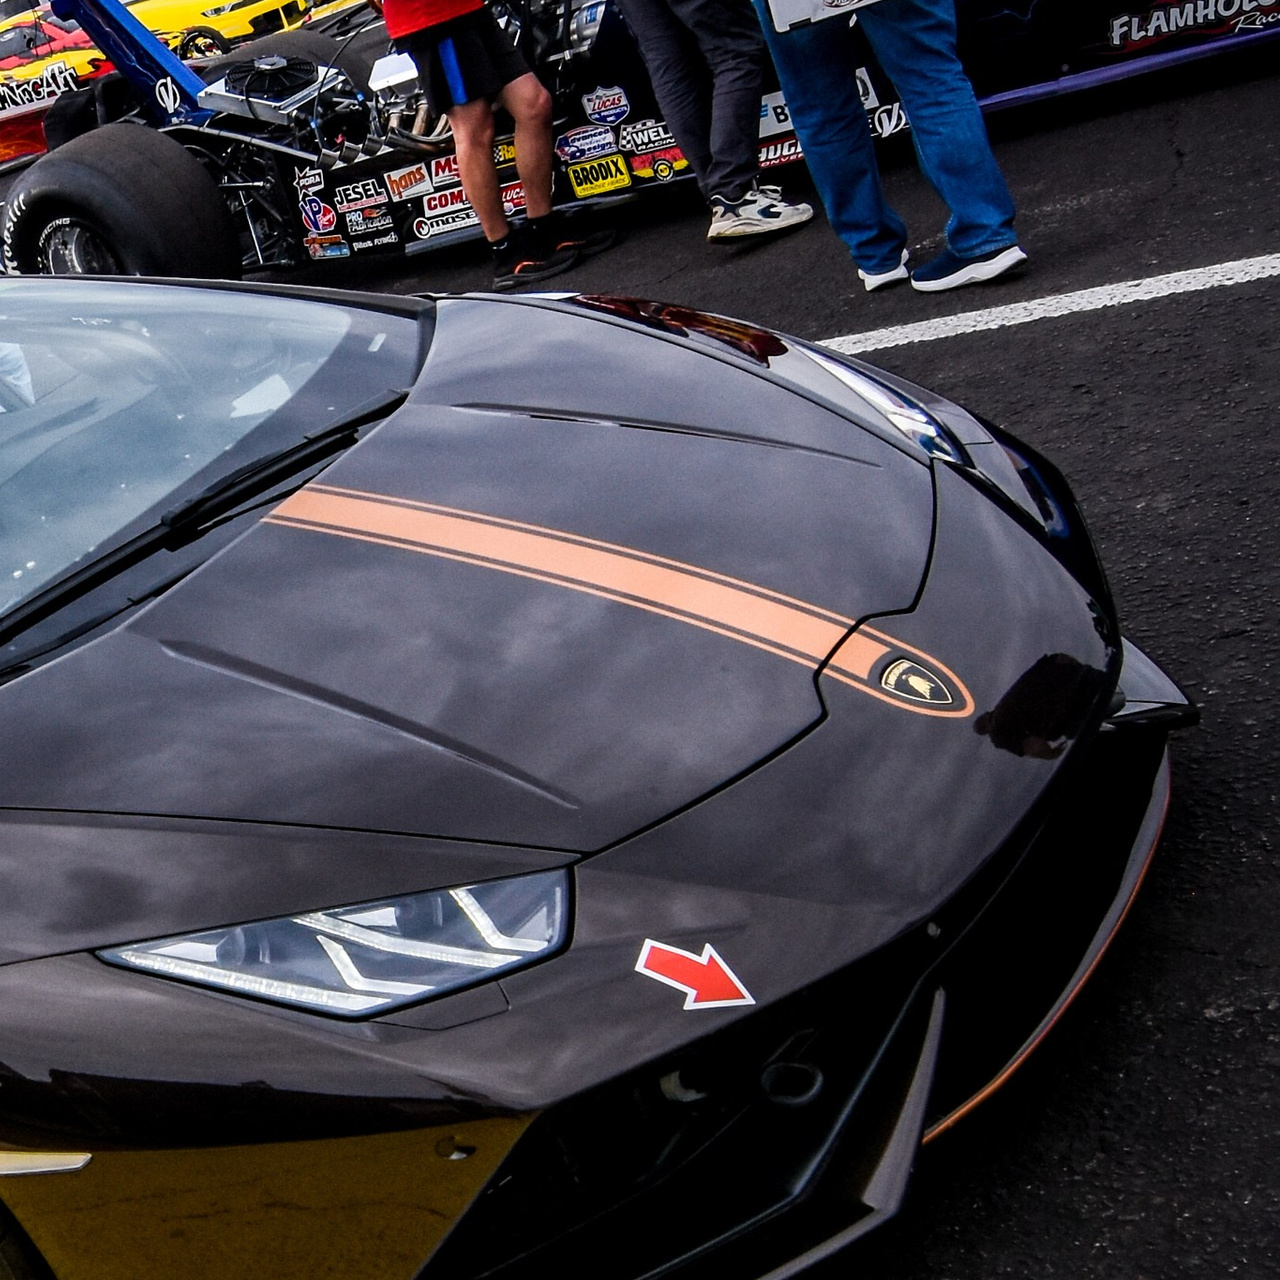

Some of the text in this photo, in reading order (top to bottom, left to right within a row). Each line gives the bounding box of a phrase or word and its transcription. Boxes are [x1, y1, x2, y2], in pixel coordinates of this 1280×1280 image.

[1230, 12, 1280, 33] Rac
[591, 95, 623, 111] LUCAS
[632, 126, 673, 145] WEL
[637, 138, 676, 151] RACIN
[572, 158, 625, 187] BRODIX
[335, 180, 384, 205] JESEL
[502, 187, 525, 202] LUCA
